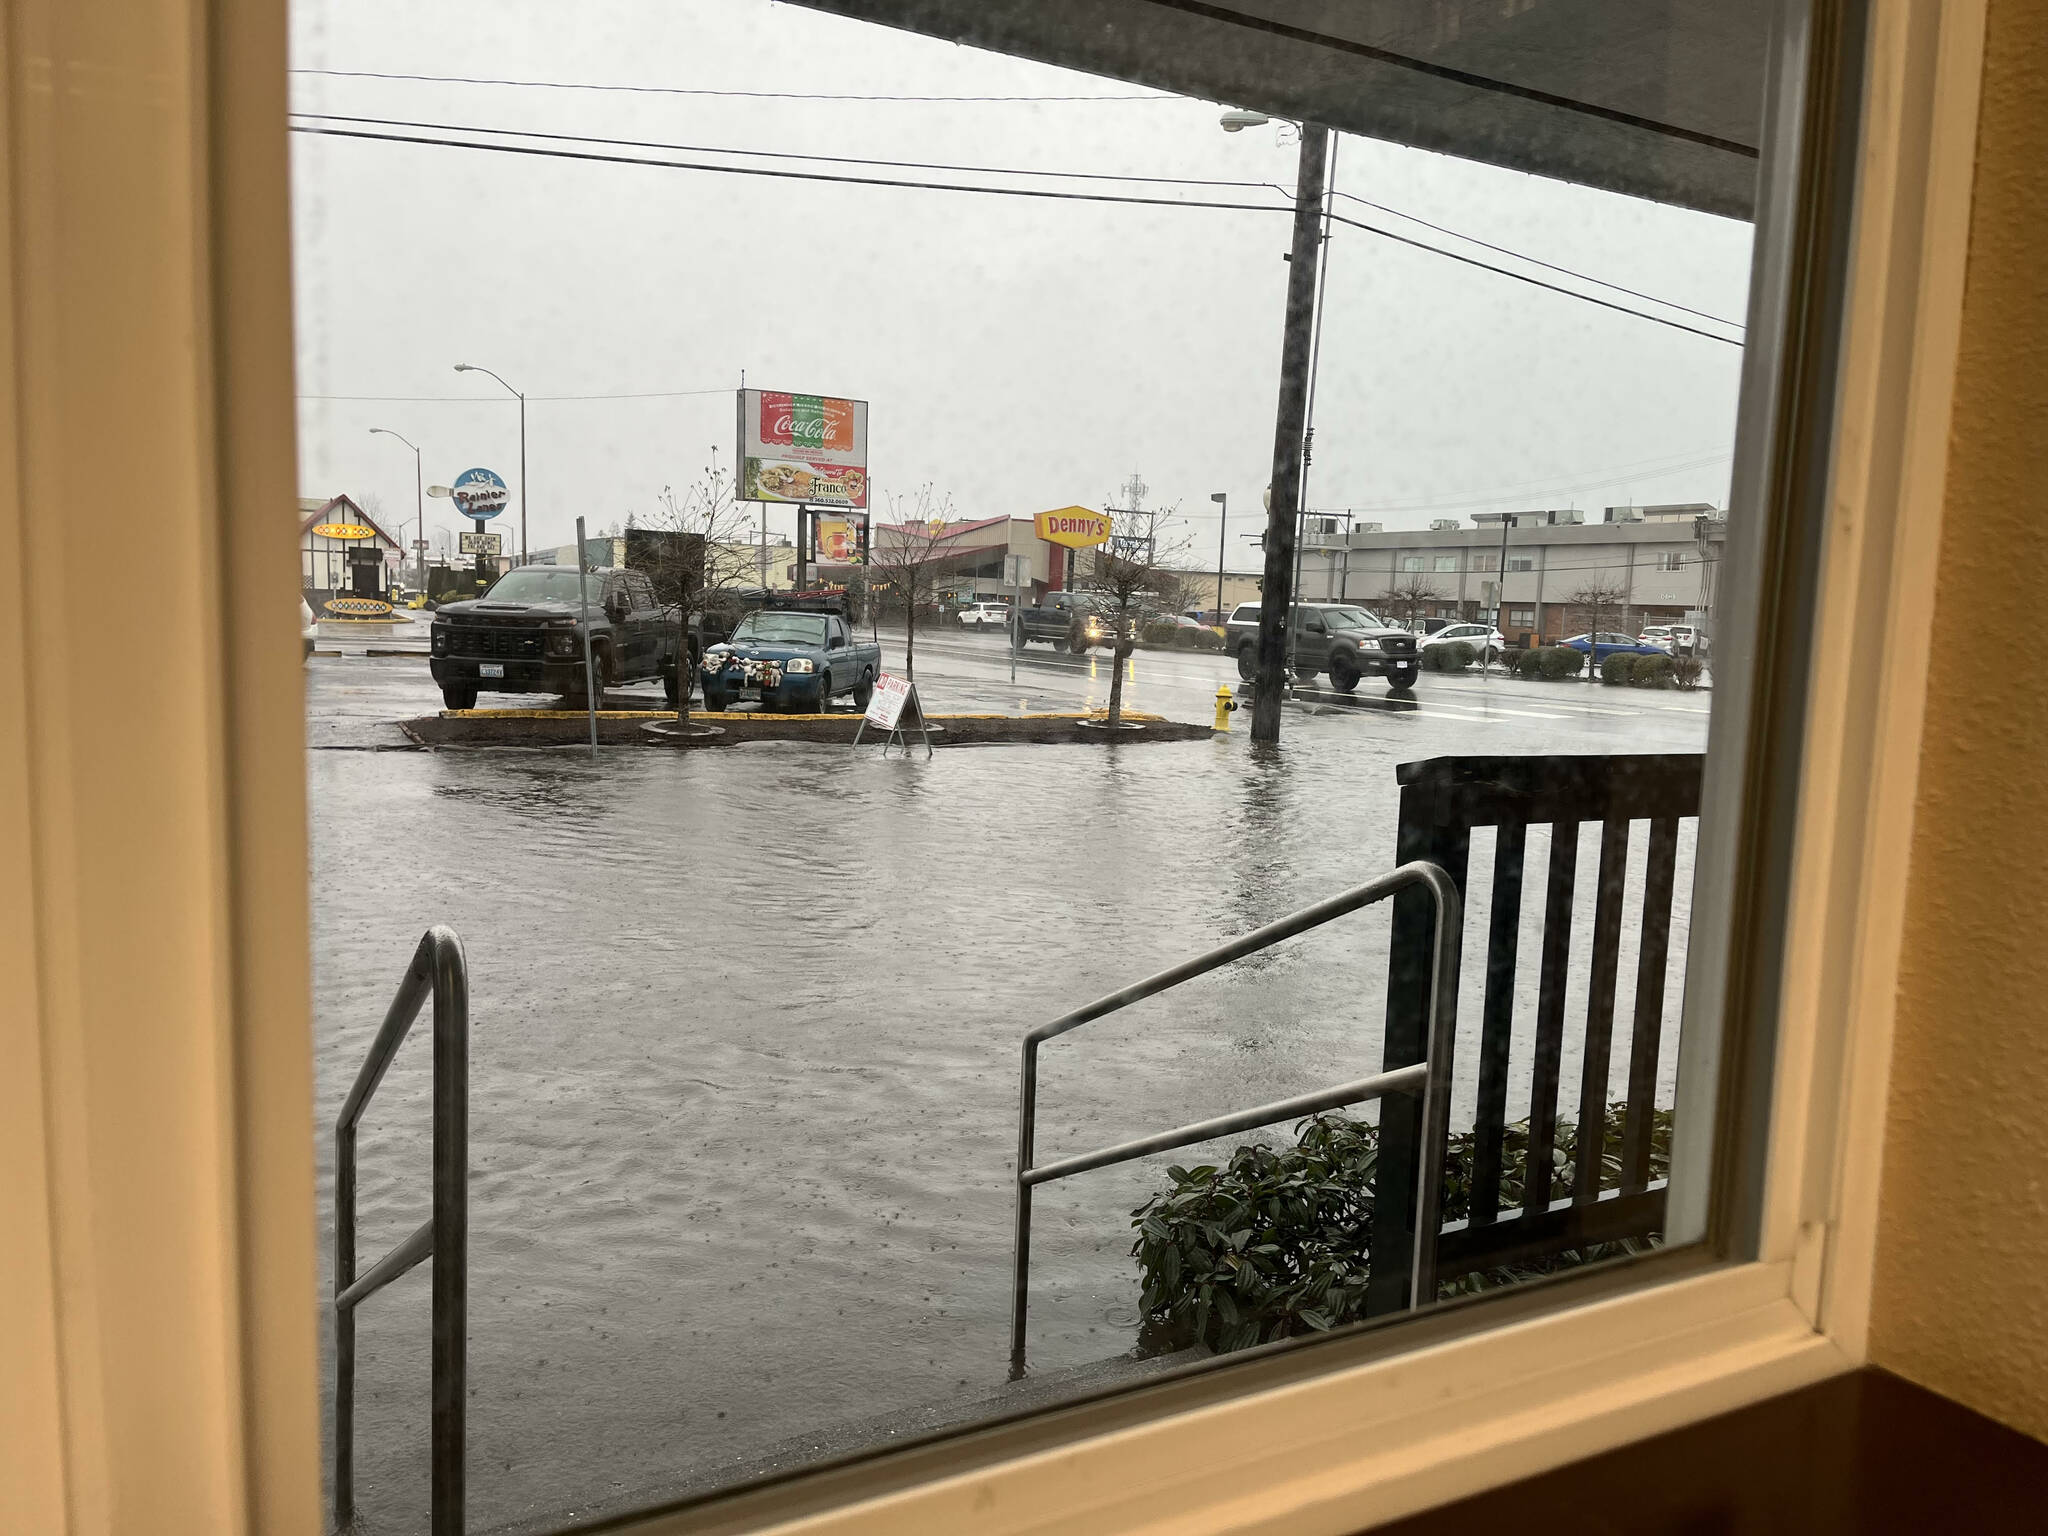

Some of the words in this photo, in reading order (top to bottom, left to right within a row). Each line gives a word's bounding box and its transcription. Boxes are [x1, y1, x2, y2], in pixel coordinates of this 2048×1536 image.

[774, 415, 840, 440] Coca-Cola
[808, 477, 848, 496] Franco
[457, 490, 506, 505] Rainier
[467, 502, 502, 515] Lanes
[1048, 516, 1105, 537] Denny's
